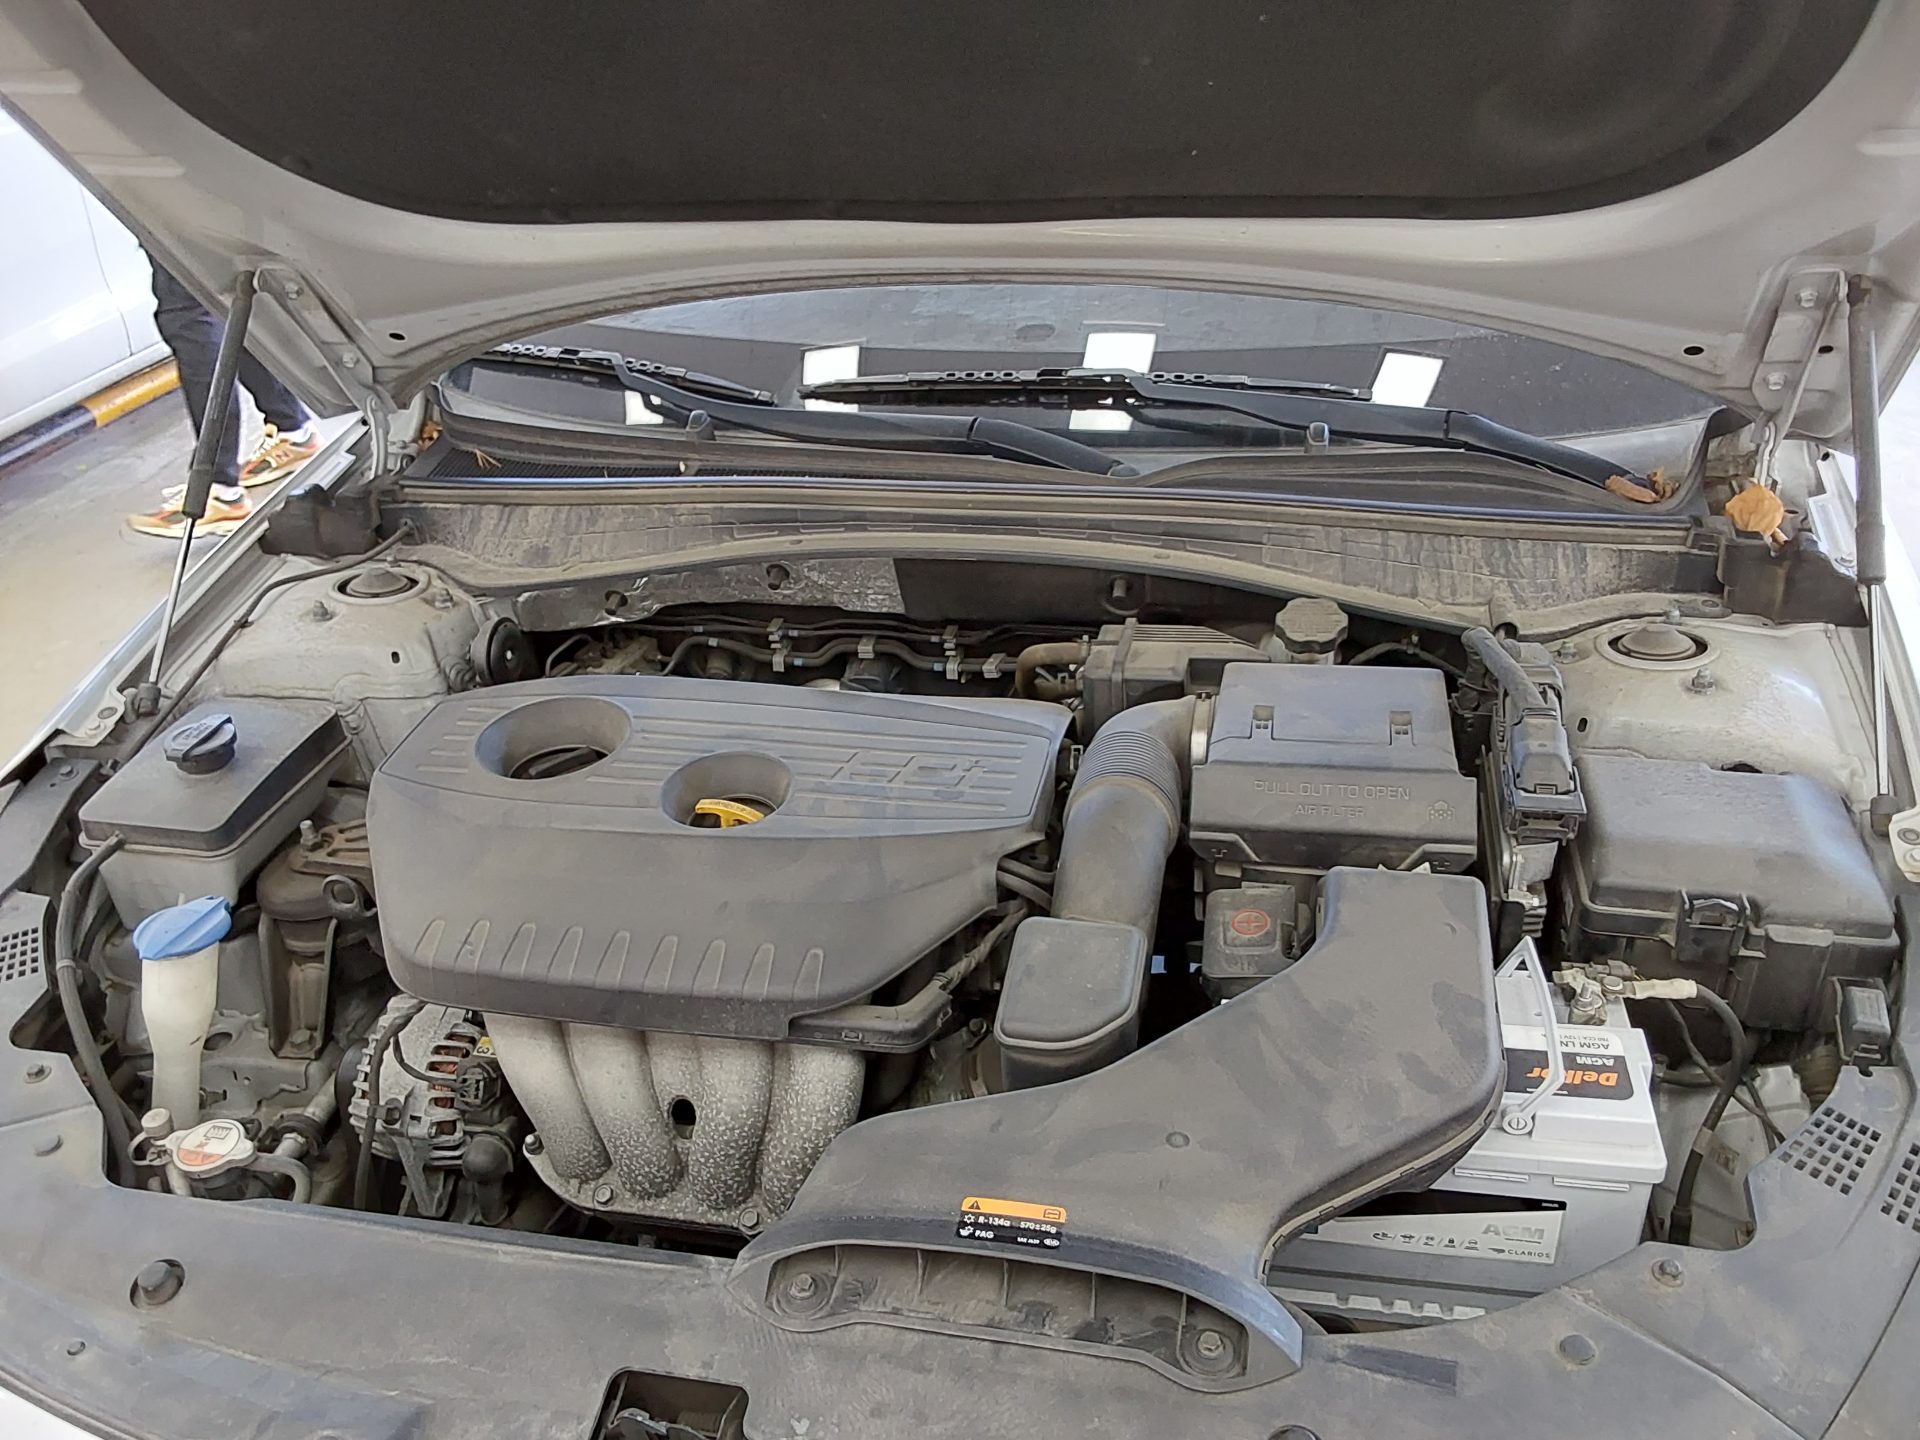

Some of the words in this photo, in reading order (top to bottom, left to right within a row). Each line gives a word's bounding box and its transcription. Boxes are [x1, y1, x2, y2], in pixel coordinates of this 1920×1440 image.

[1254, 780, 1295, 795] PULL
[1299, 782, 1333, 797] OUT
[1337, 784, 1359, 798] TO
[1363, 785, 1409, 800] OPEN
[1295, 804, 1318, 816] AIR
[1321, 804, 1365, 818] FILTER
[1559, 1040, 1576, 1048] LN
[1579, 1041, 1610, 1050] AGM
[1576, 1055, 1615, 1066] AGM
[978, 1215, 1011, 1227] R-134a
[974, 1229, 994, 1239] PAG
[1481, 1224, 1544, 1240] AGM
[1507, 1249, 1550, 1258] CLARIOS
